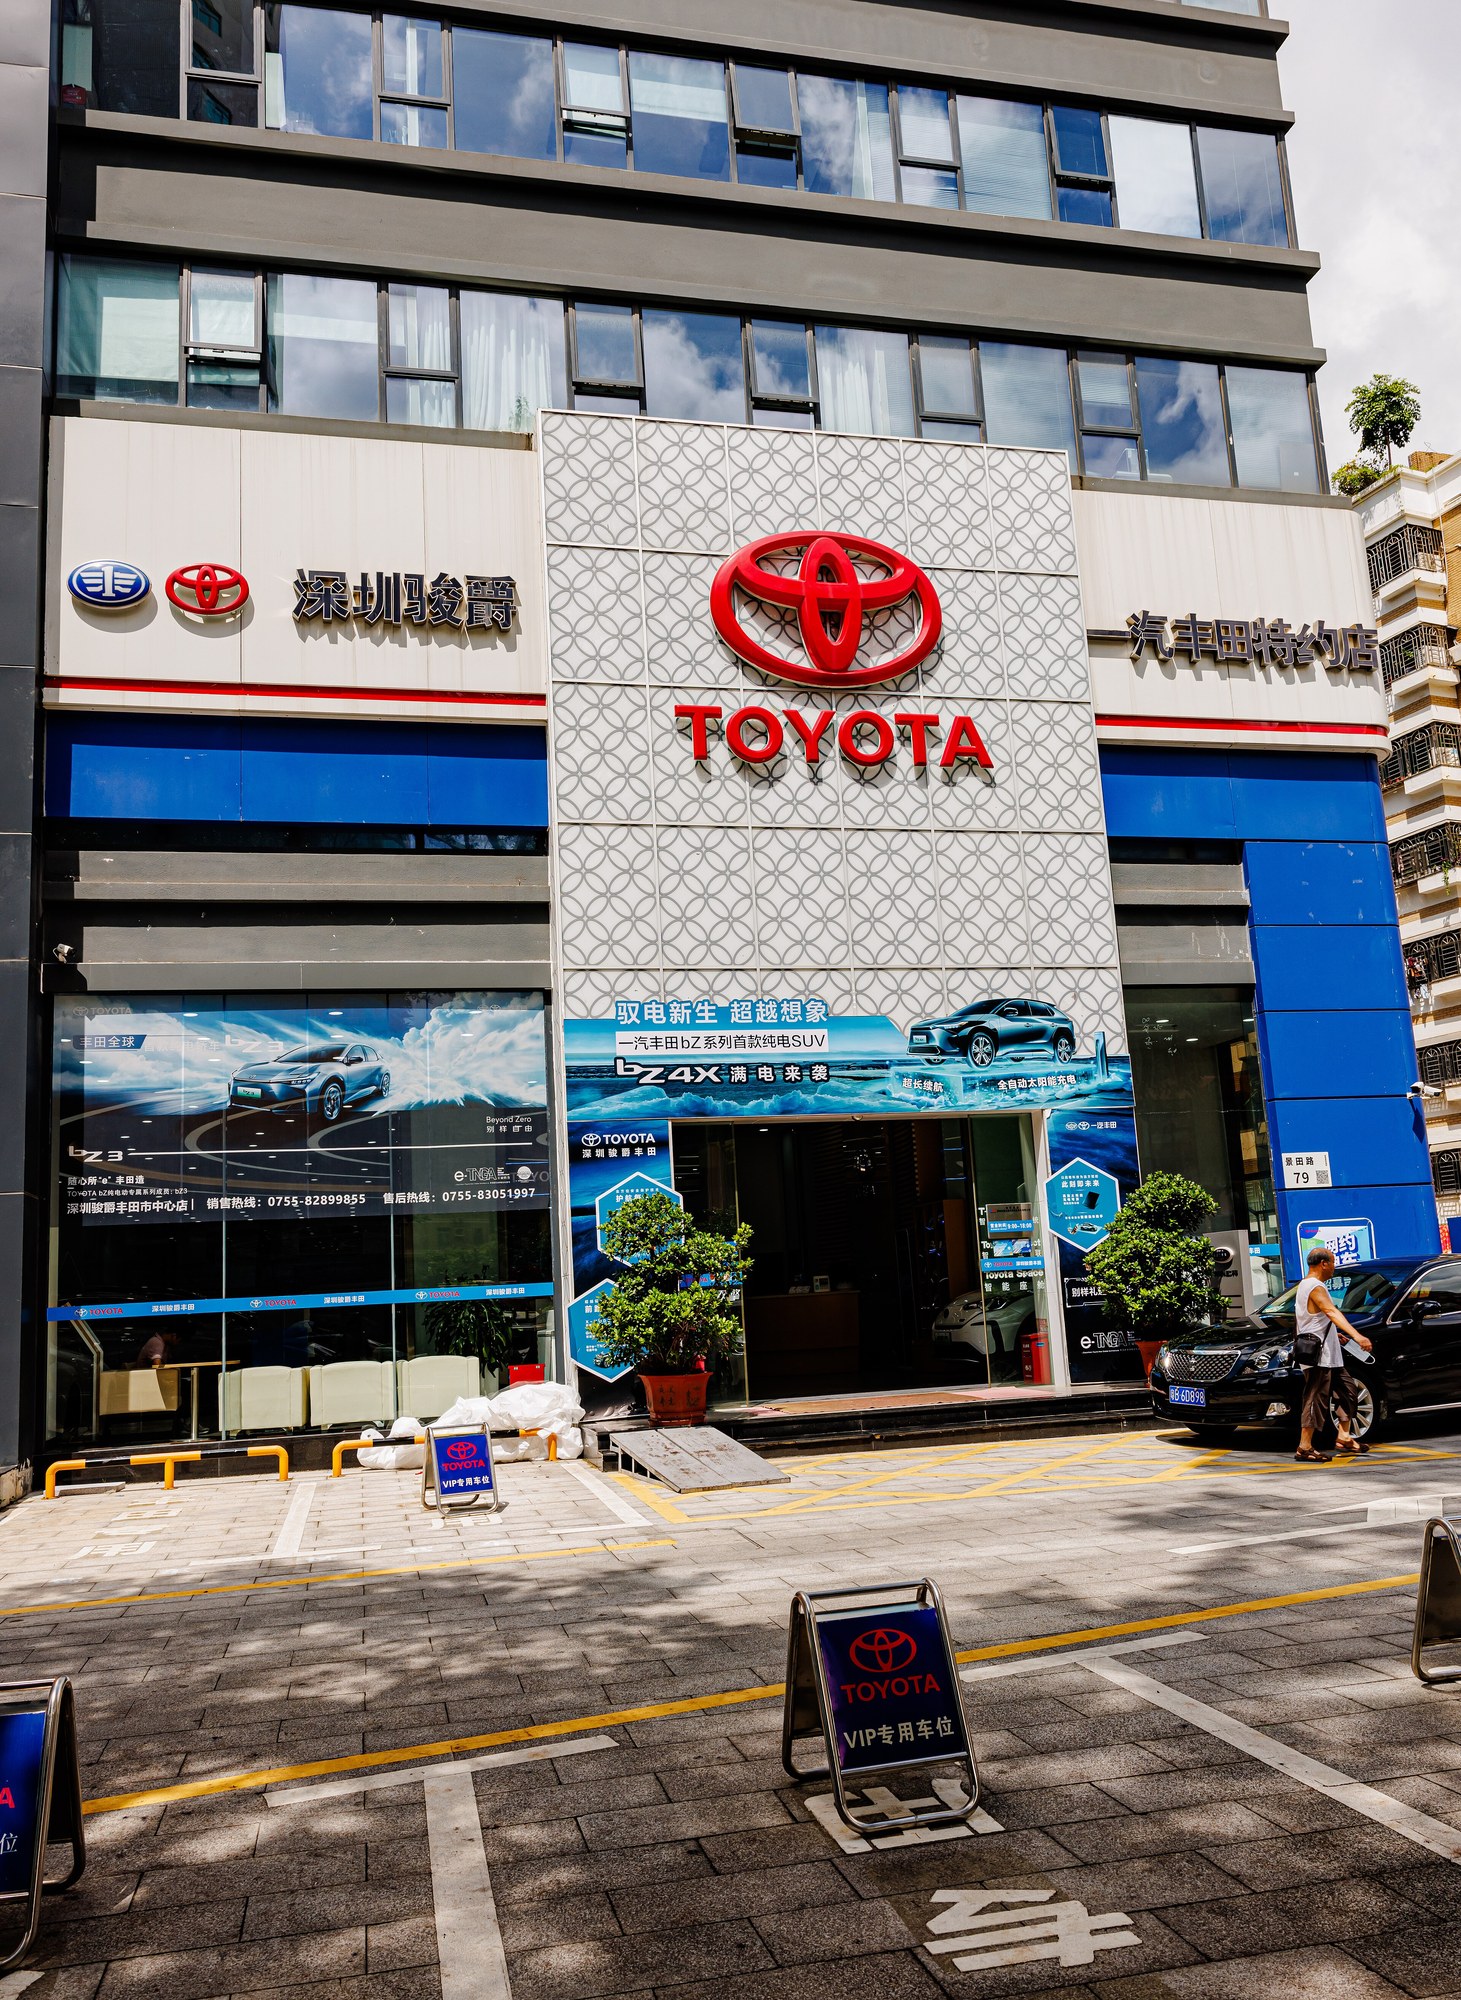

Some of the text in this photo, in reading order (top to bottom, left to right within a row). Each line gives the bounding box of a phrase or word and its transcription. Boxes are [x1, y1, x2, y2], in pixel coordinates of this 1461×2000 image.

[293, 569, 518, 632] 深圳骏爵
[1086, 609, 1378, 673] 一汽丰田特约店
[674, 704, 995, 769] TOYOTA
[90, 1006, 132, 1015] TOYOTA
[617, 1000, 828, 1025] 驭电新生 超越想象
[79, 1035, 136, 1049] 丰田全球
[618, 1034, 826, 1051] 一汽丰田bZ系列首款纯电SUV
[615, 1057, 829, 1084] bZ4X 满电来袭
[902, 1077, 945, 1092] 超长续航
[997, 1074, 1077, 1090] 全自动太阳能充电
[486, 1114, 532, 1125] Beyond Zero
[603, 1133, 656, 1145] TOYOTA
[582, 1147, 657, 1158] 深圳骏爵丰田
[1285, 1156, 1314, 1166] 景田路
[1293, 1171, 1310, 1184] 79
[67, 1200, 188, 1214] 深圳骏爵丰田市中心店
[267, 1193, 366, 1207] 0755-82899855
[442, 1187, 536, 1201] 0755-83051997
[89, 1307, 124, 1316] TOYOTA
[264, 1299, 297, 1307] TOYOTA
[442, 1458, 486, 1472] TOYOTA
[442, 1475, 490, 1488] VIP专用车位
[840, 1673, 941, 1704] TOYOTA
[843, 1716, 955, 1749] VIP专用车位
